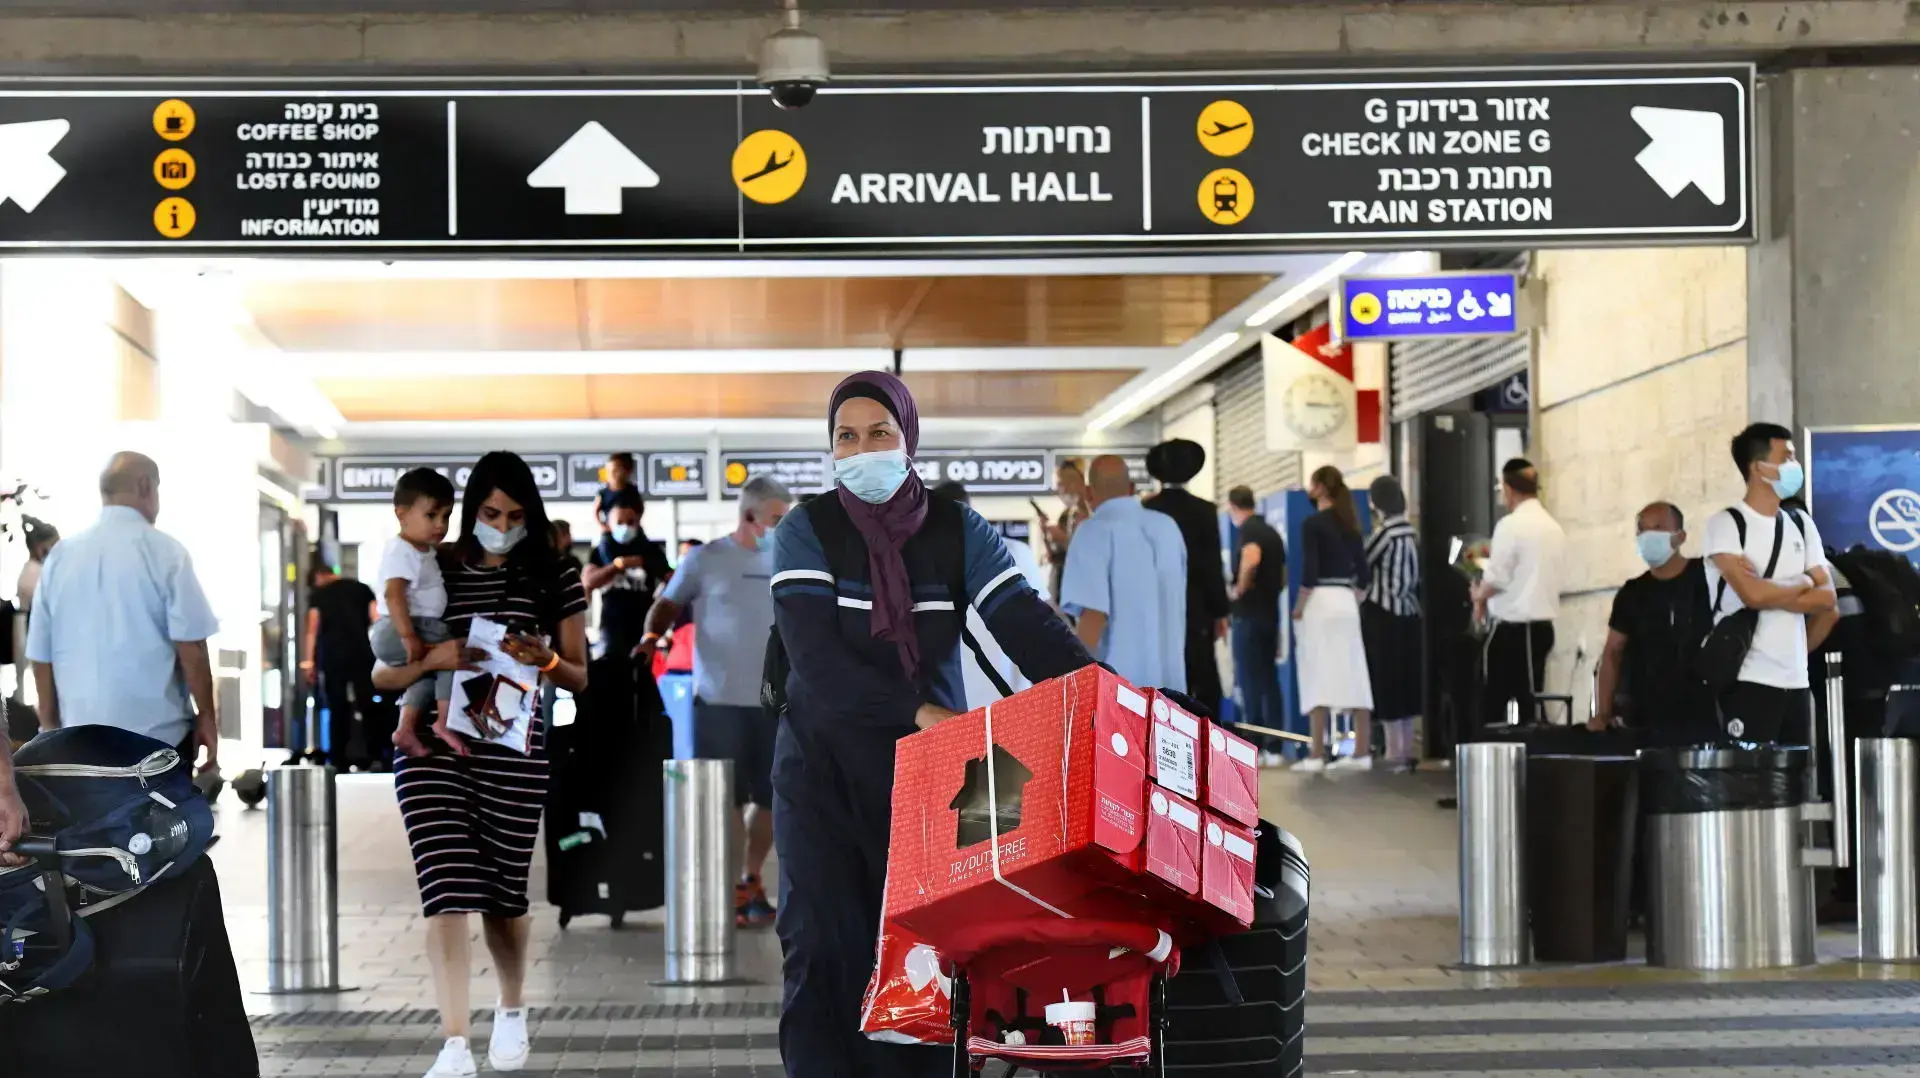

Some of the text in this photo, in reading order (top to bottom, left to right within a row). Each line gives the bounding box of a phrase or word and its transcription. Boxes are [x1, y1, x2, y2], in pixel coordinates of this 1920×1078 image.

[284, 102, 379, 124] בית קפה
[1364, 97, 1551, 129] אזור בידוק G
[237, 122, 379, 141] COFFEE SHOP
[981, 125, 1111, 155] נחיתות
[1301, 128, 1551, 157] CHECK IN ZONE G
[246, 152, 379, 169] איתור כבודה
[237, 172, 381, 190] LOST & FOUND
[830, 171, 1113, 204] ARRIVAL HALL
[1377, 165, 1552, 192] תחנת רכבת
[303, 198, 379, 219] מודיעין
[1327, 196, 1553, 225] TRAIN STATION
[241, 218, 380, 236] INFORMATION
[998, 837, 1027, 859] FREE
